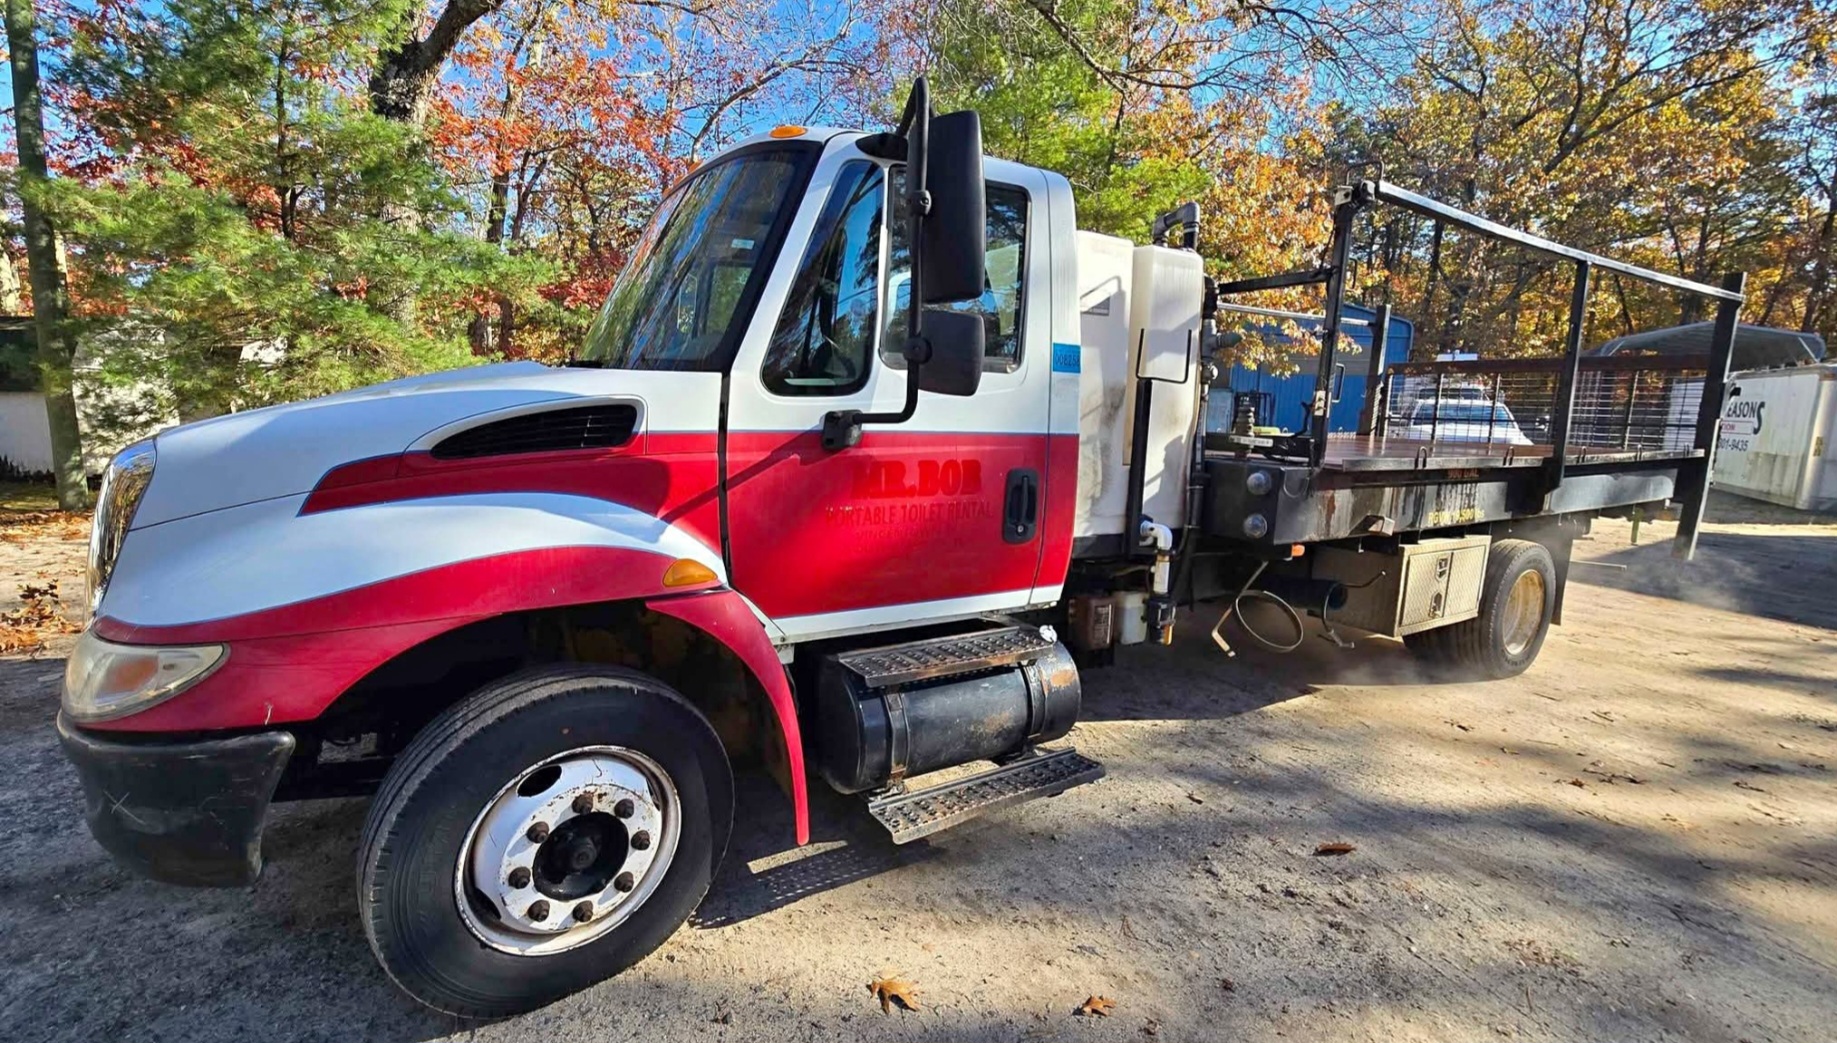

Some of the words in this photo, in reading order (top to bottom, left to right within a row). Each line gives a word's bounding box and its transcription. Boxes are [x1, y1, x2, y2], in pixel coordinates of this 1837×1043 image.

[1726, 400, 1765, 435] EASONS
[826, 505, 896, 527] PORTABLE
[901, 502, 944, 523] TOILET
[948, 500, 993, 520] RENTAL
